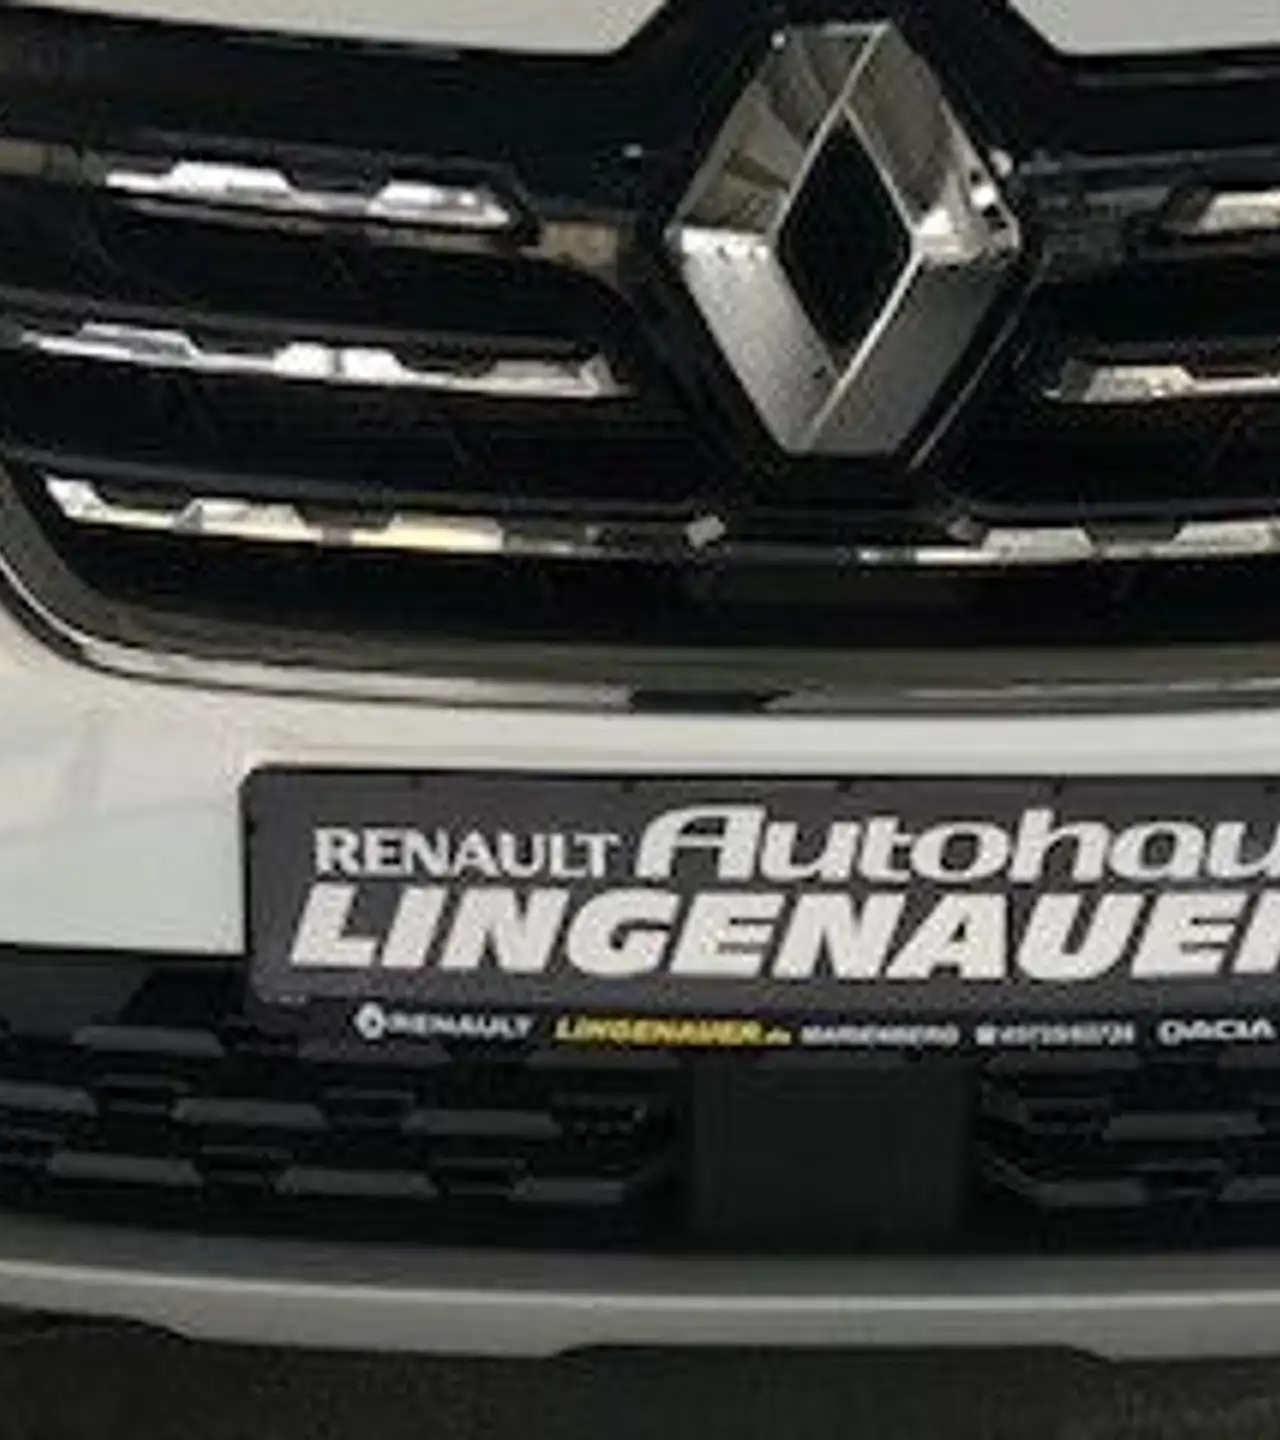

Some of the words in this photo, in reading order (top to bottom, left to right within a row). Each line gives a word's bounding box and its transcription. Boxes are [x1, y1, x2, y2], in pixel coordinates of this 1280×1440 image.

[315, 827, 620, 879] RENAULT
[385, 1011, 532, 1040] RENAULT
[1158, 1019, 1277, 1043] DACIA
